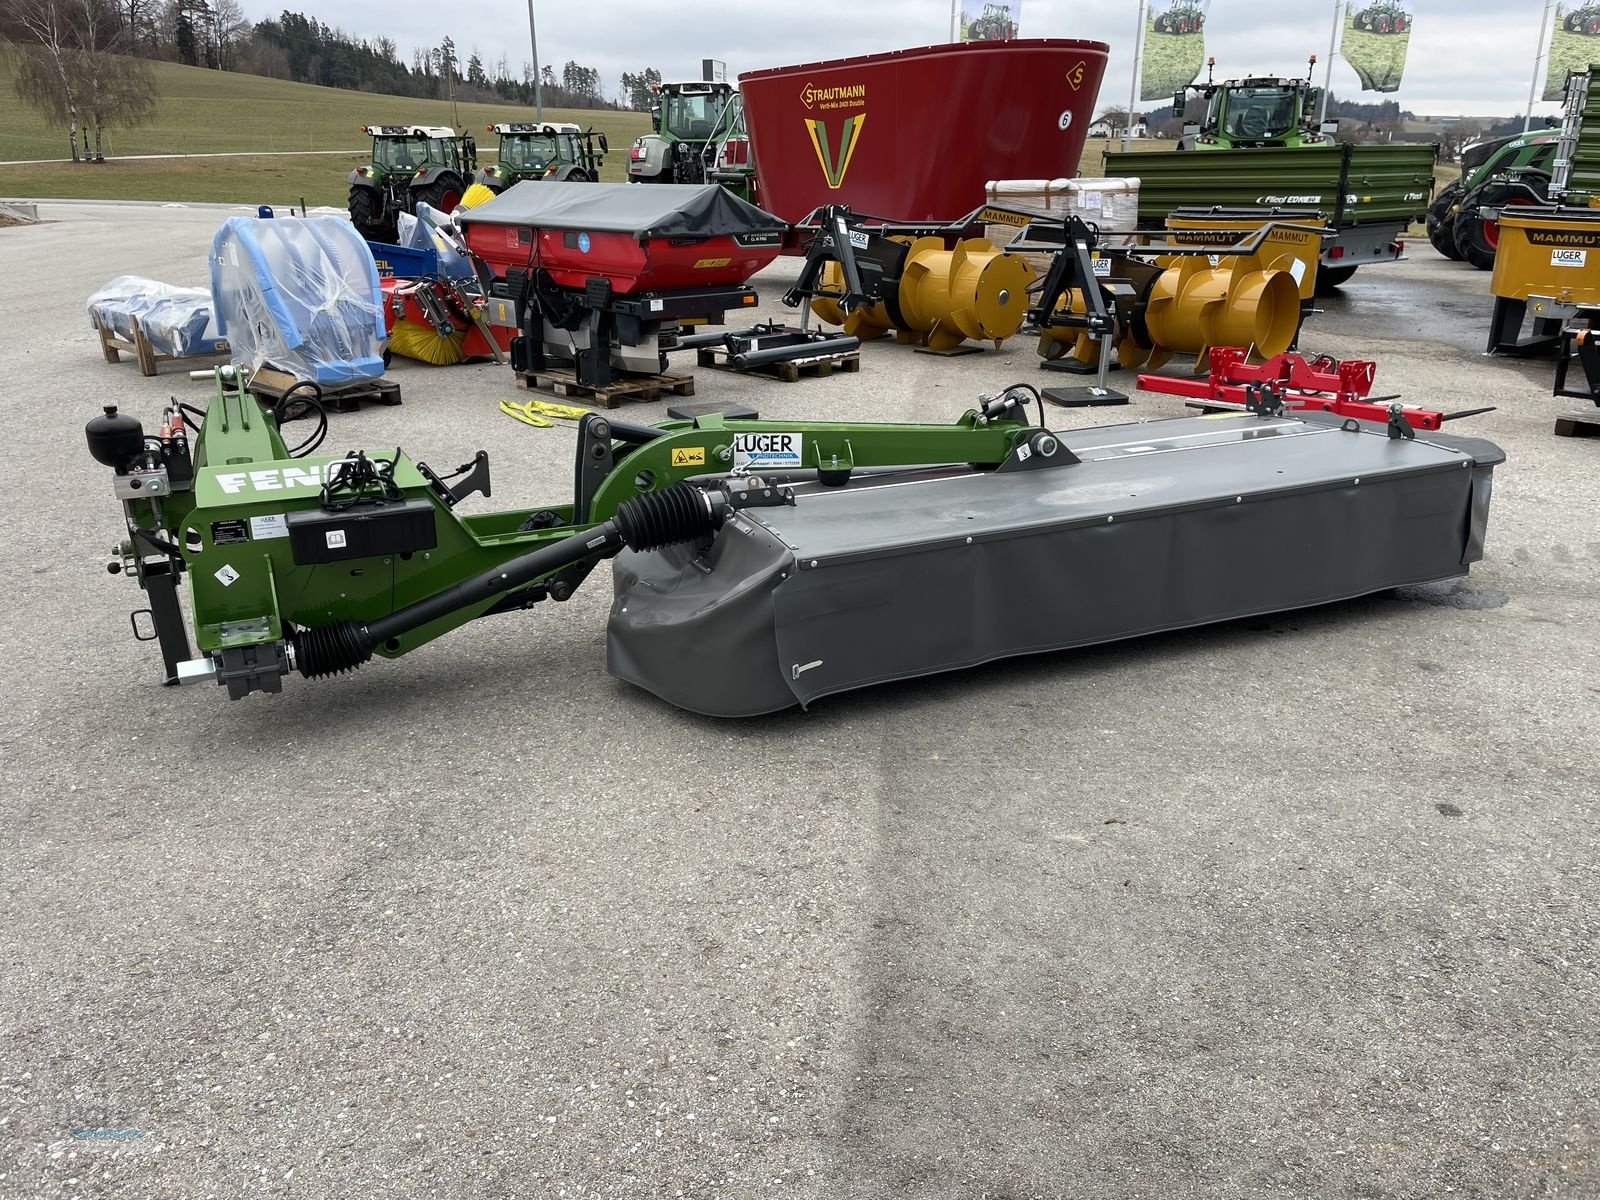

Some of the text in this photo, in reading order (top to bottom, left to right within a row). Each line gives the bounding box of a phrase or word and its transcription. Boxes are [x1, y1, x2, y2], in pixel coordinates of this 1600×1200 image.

[806, 84, 865, 102] STRAUTMANN
[1062, 113, 1069, 126] 6
[984, 211, 1025, 225] MAMMUT
[849, 230, 867, 242] UGER
[1177, 234, 1235, 242] MAMMUT
[1271, 231, 1308, 243] MAMMUT
[1553, 250, 1581, 260] LUGER
[376, 260, 394, 270] EIL
[1091, 259, 1109, 269] UGER
[736, 434, 793, 452] LUGER
